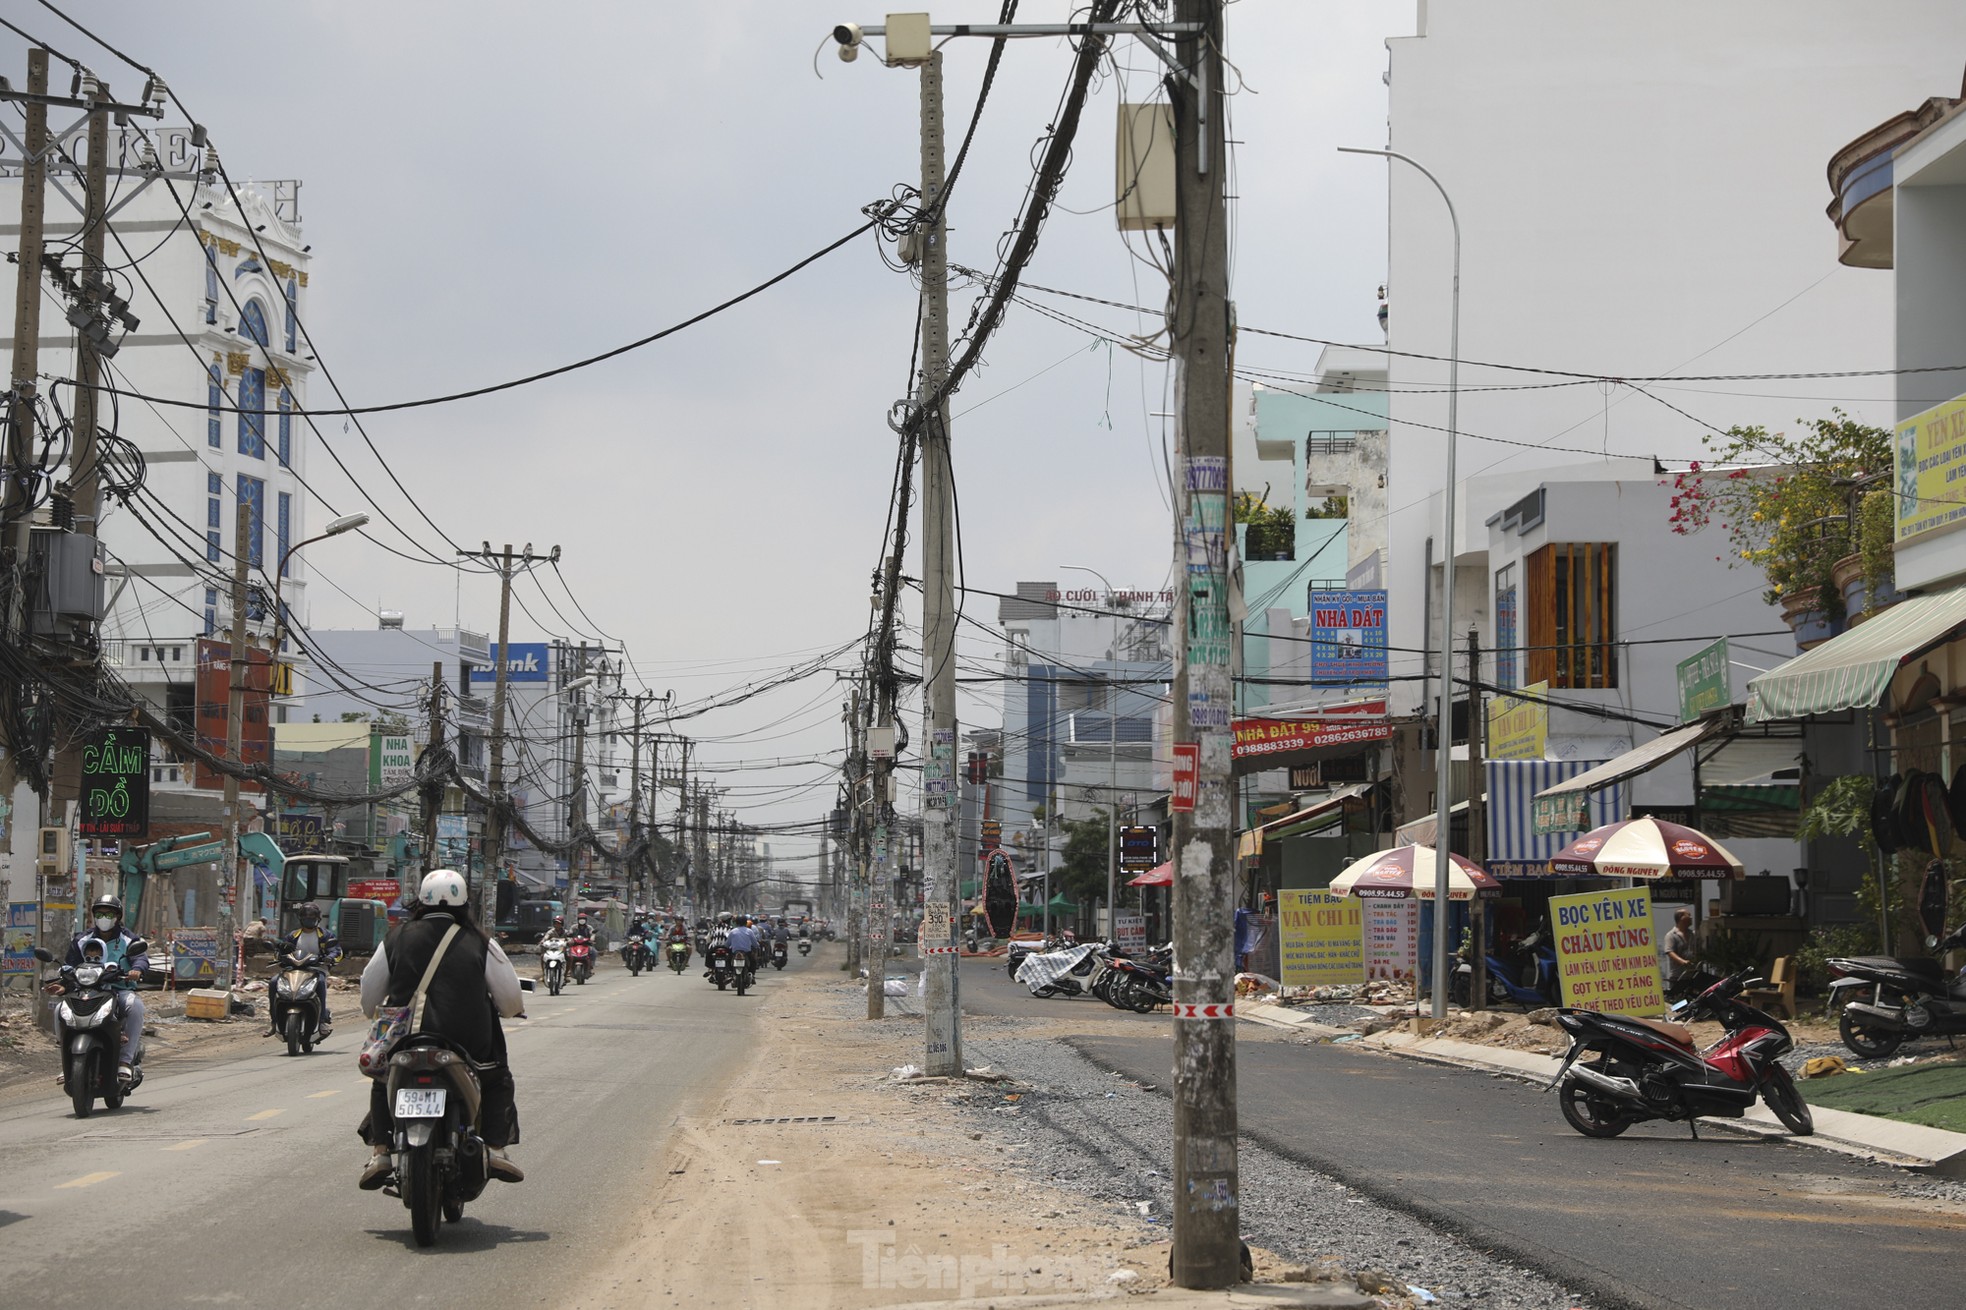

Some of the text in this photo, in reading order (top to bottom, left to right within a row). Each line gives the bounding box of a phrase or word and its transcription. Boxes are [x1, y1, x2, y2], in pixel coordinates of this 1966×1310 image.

[1066, 587, 1097, 602] CƯỚI
[1316, 604, 1383, 628] NHÀ ĐẤT
[1236, 722, 1265, 743] NHÀ
[1237, 727, 1388, 755] 0988883339 02862636789
[386, 738, 408, 750] NHA
[383, 754, 411, 767] KHOA
[89, 777, 130, 818] ĐỒ
[1491, 861, 1524, 878] TIỆM
[1298, 892, 1321, 907] TIỆM
[1358, 888, 1405, 899] 0908.95.44.55
[1282, 909, 1360, 930] VẠN CHI II
[1559, 897, 1647, 928] BỌC YÊN XE
[1561, 925, 1651, 955] CHÂU TÙNG
[1629, 957, 1641, 970] KIM
[1572, 983, 1591, 998] GỌT
[1594, 978, 1615, 992] YÊN
[1618, 979, 1624, 990] 2
[1603, 998, 1624, 1011] THEO
[1626, 994, 1641, 1008] YÊU
